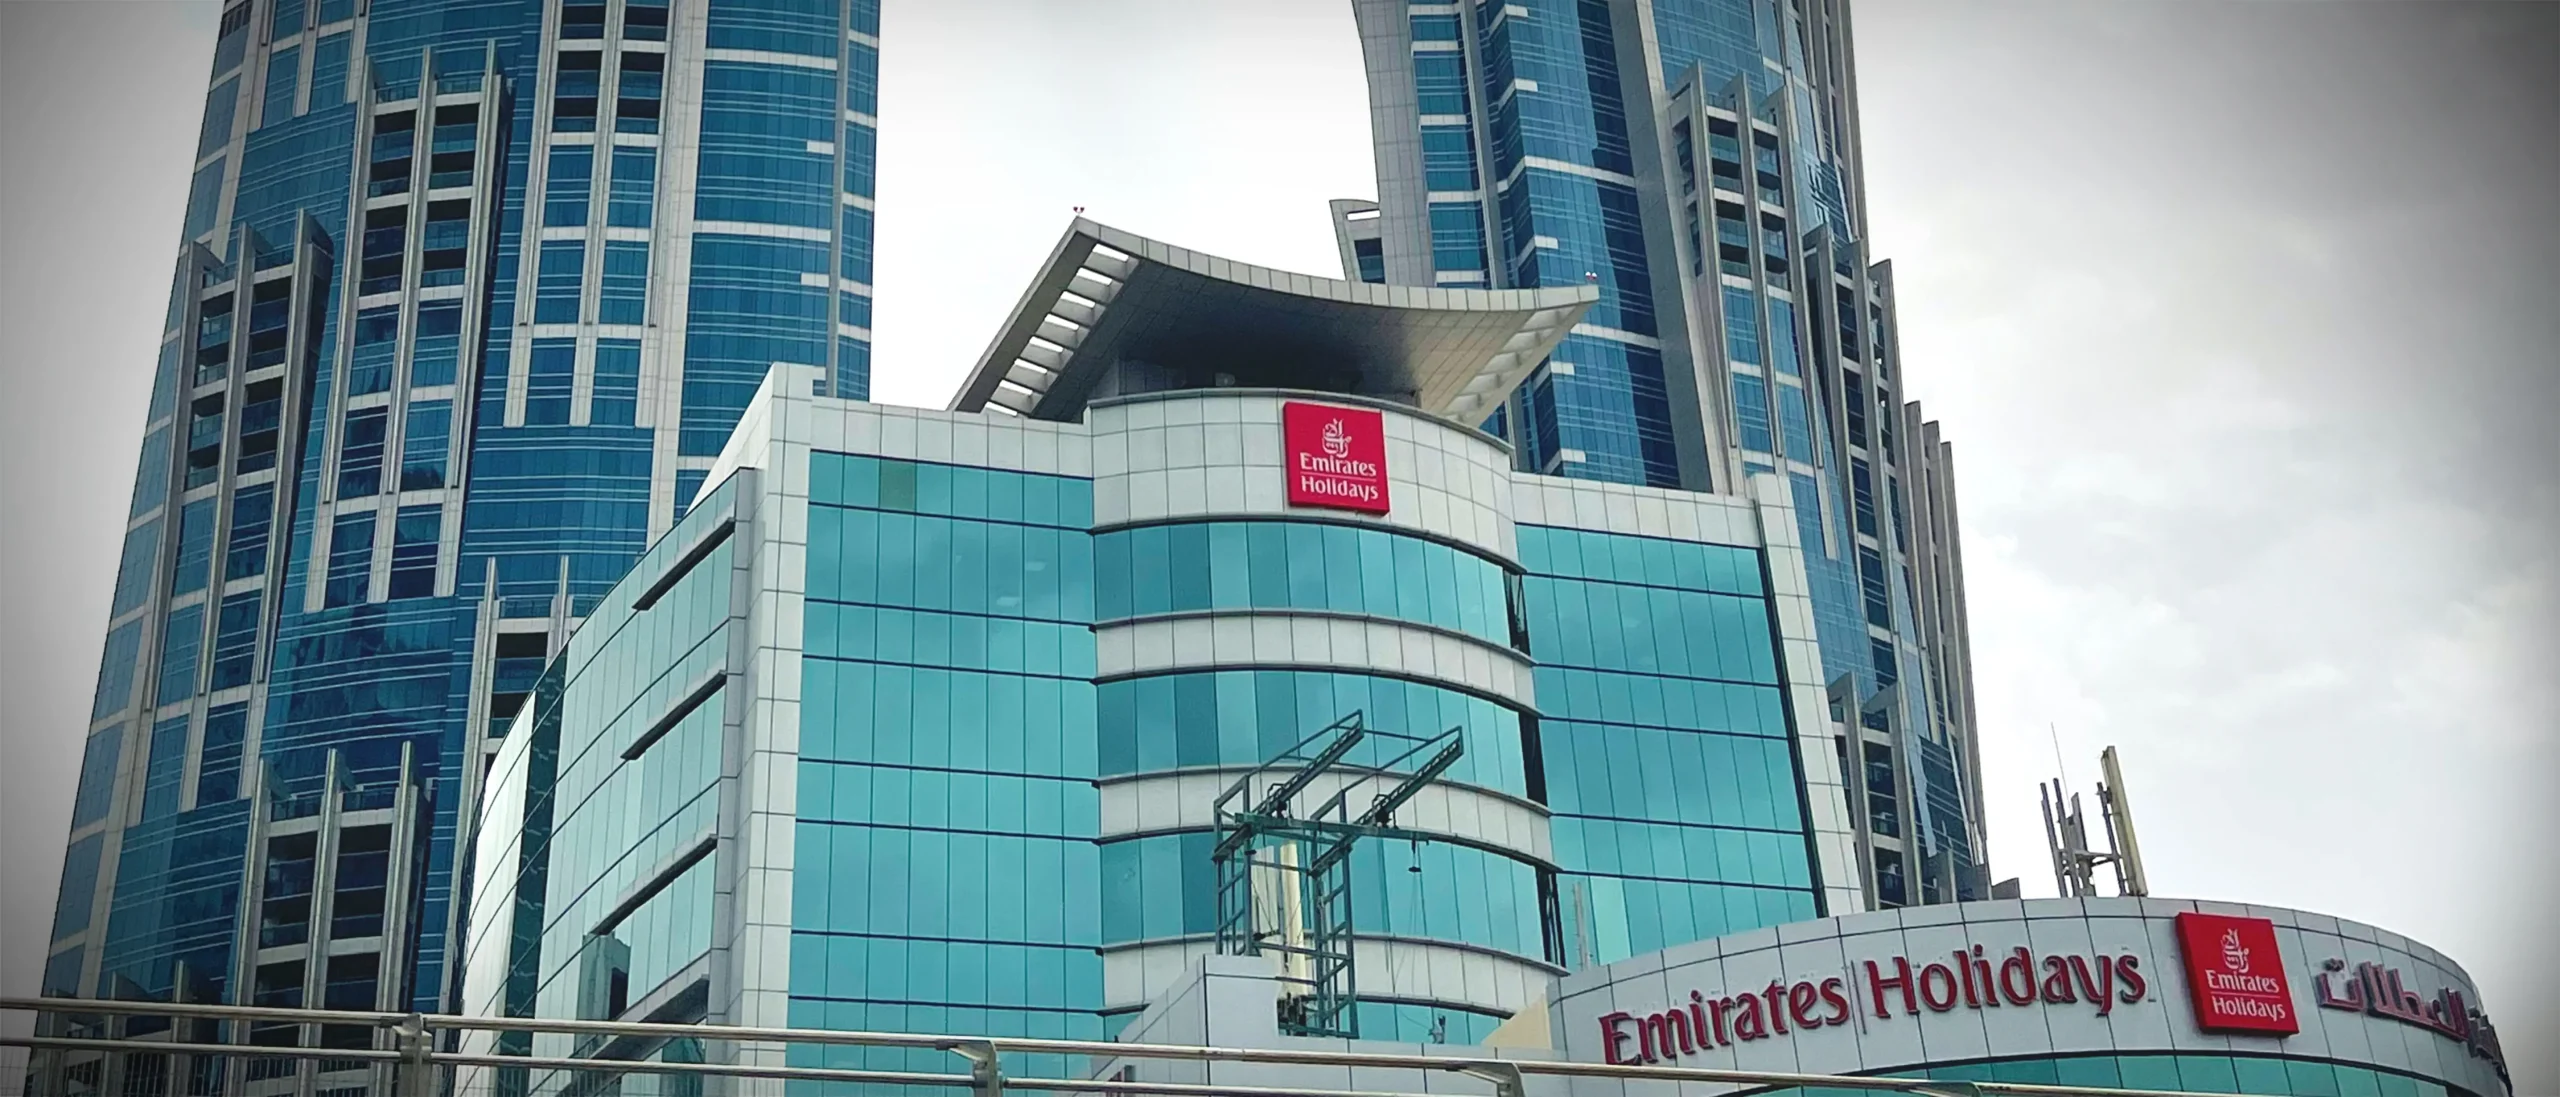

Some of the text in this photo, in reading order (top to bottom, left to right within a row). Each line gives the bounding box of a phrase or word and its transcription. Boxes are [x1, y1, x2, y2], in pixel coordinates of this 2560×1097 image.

[1300, 452, 1376, 476] Emirates
[1300, 475, 1379, 502] Holidays
[2205, 969, 2280, 993] Emirates
[1598, 977, 1850, 1066] Emirates
[1863, 944, 2147, 1018] Holidays
[2211, 995, 2286, 1022] Holidays
